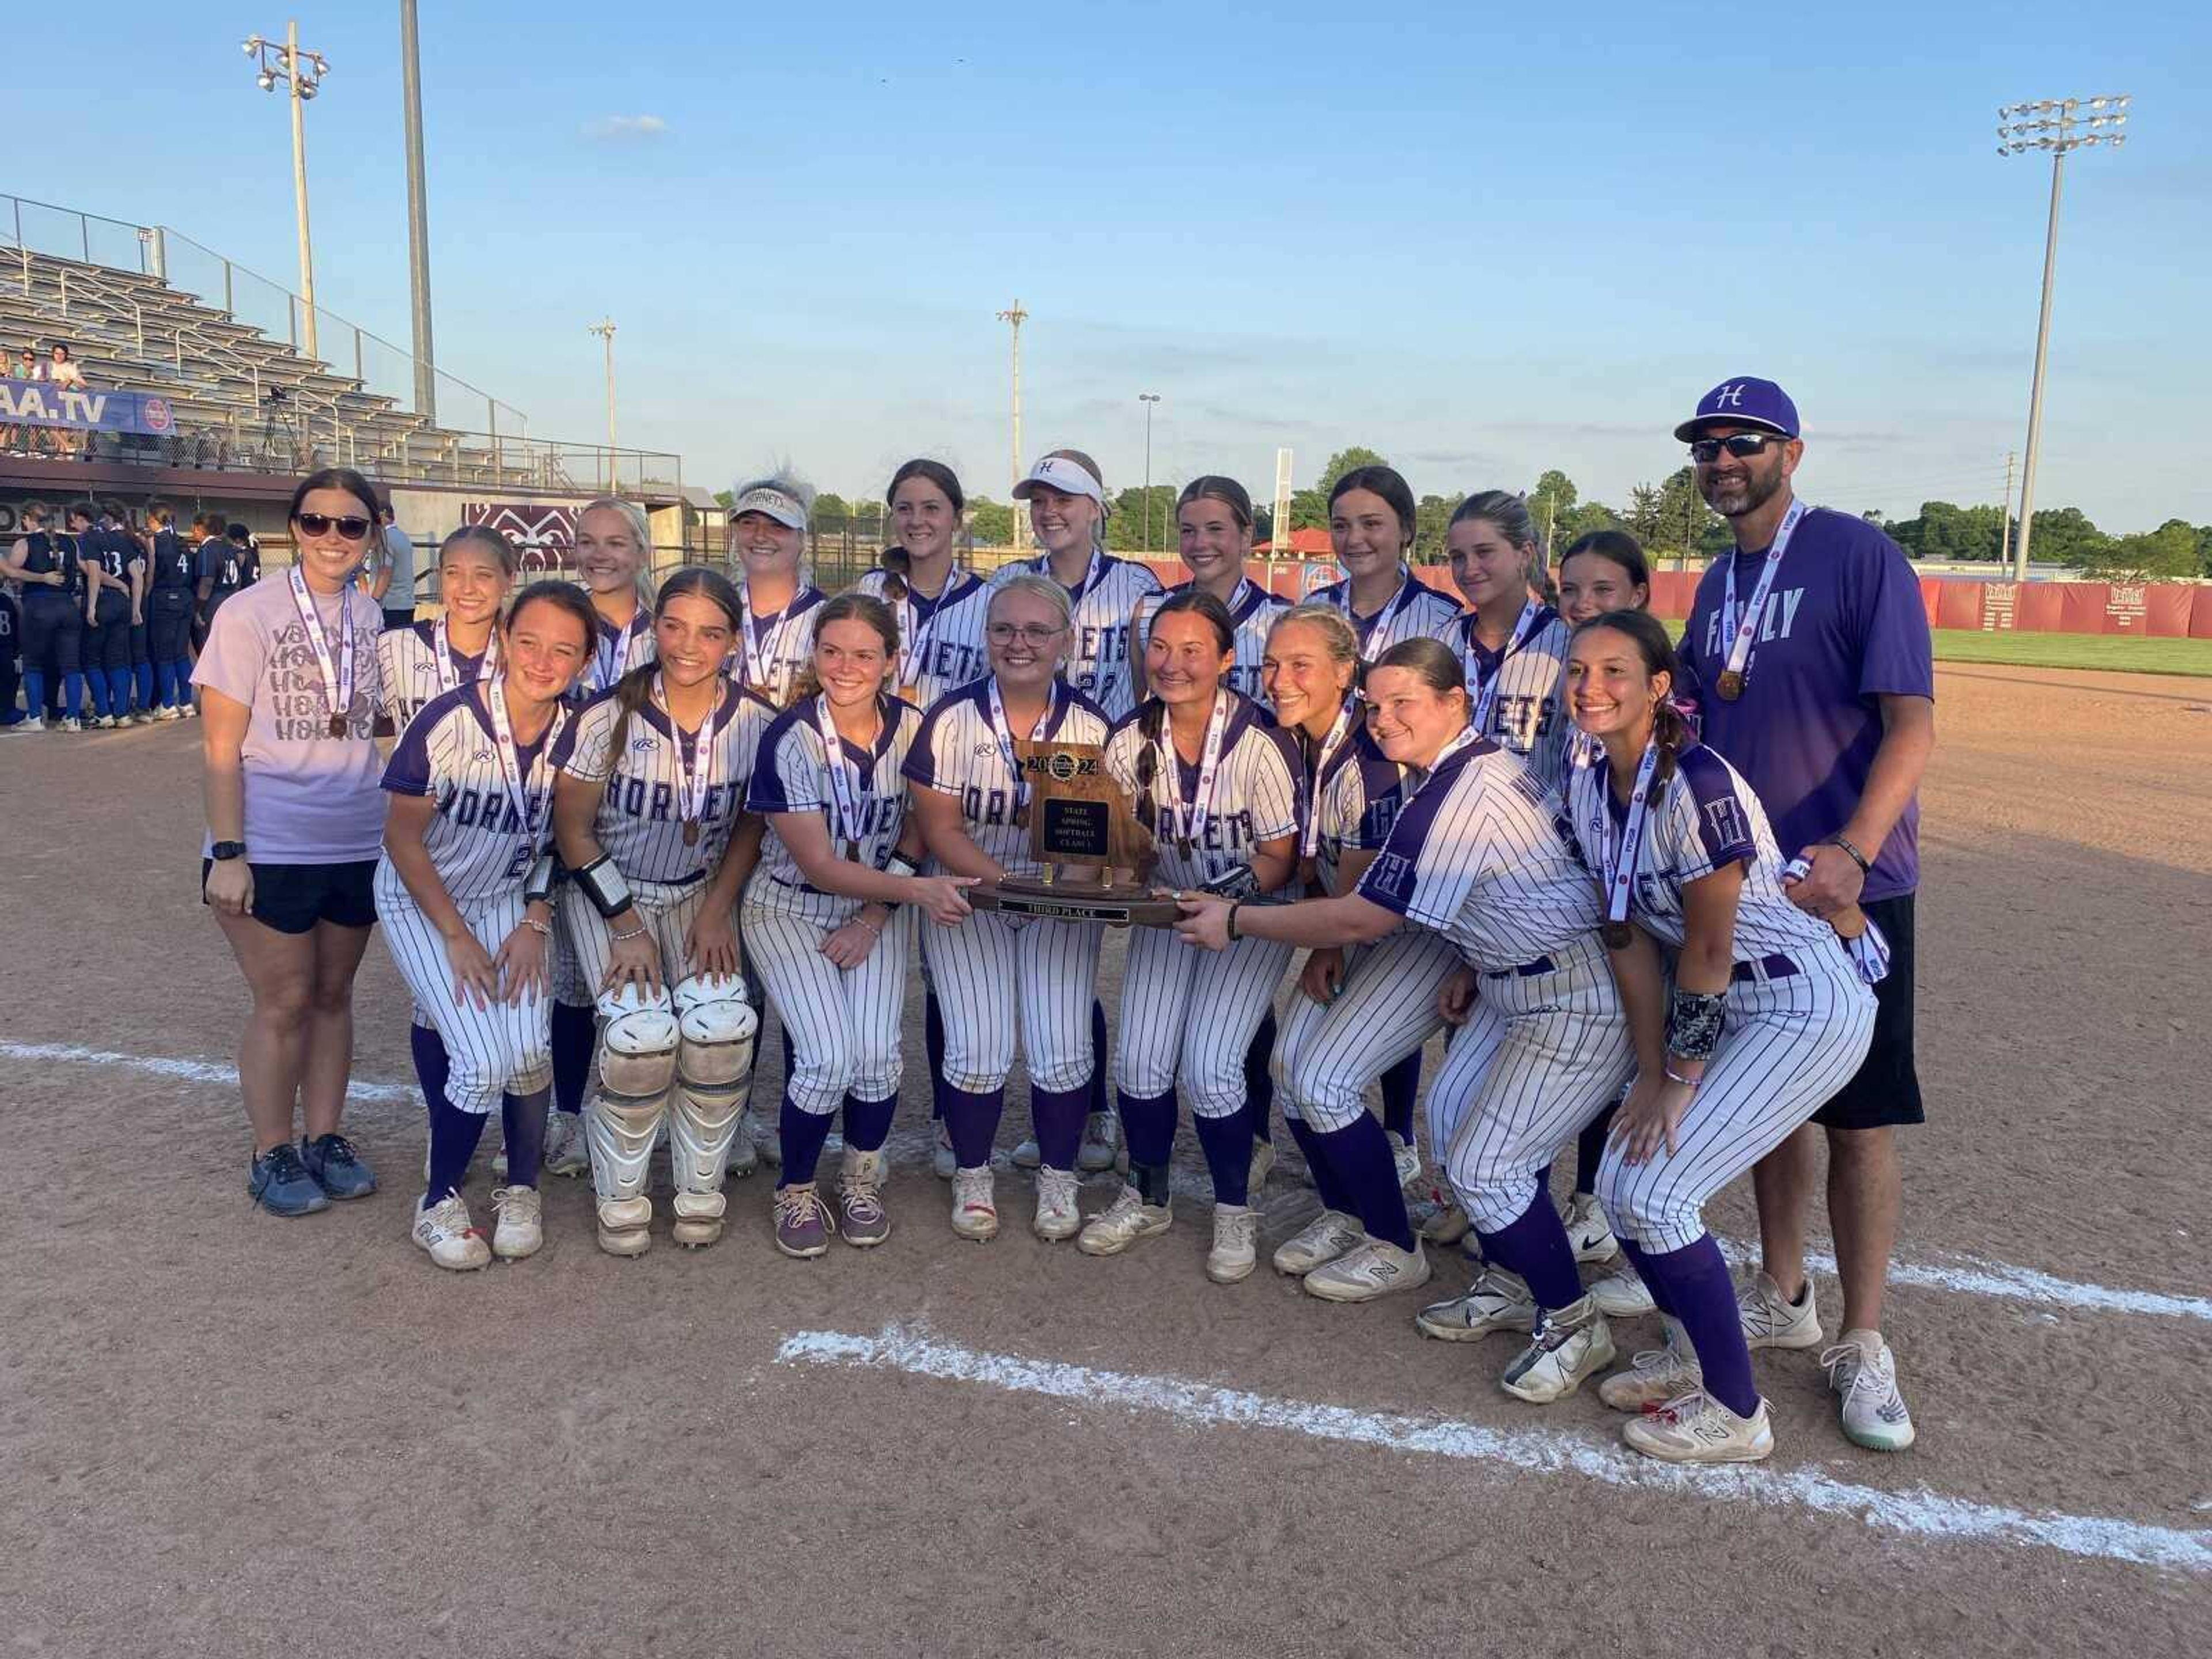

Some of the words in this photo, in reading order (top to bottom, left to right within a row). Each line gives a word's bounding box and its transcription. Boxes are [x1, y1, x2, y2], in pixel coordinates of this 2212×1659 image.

[1717, 384, 1746, 408] H
[177, 553, 188, 573] 4
[1028, 903, 1059, 915] THIRD
[1062, 908, 1096, 918] PLACE
